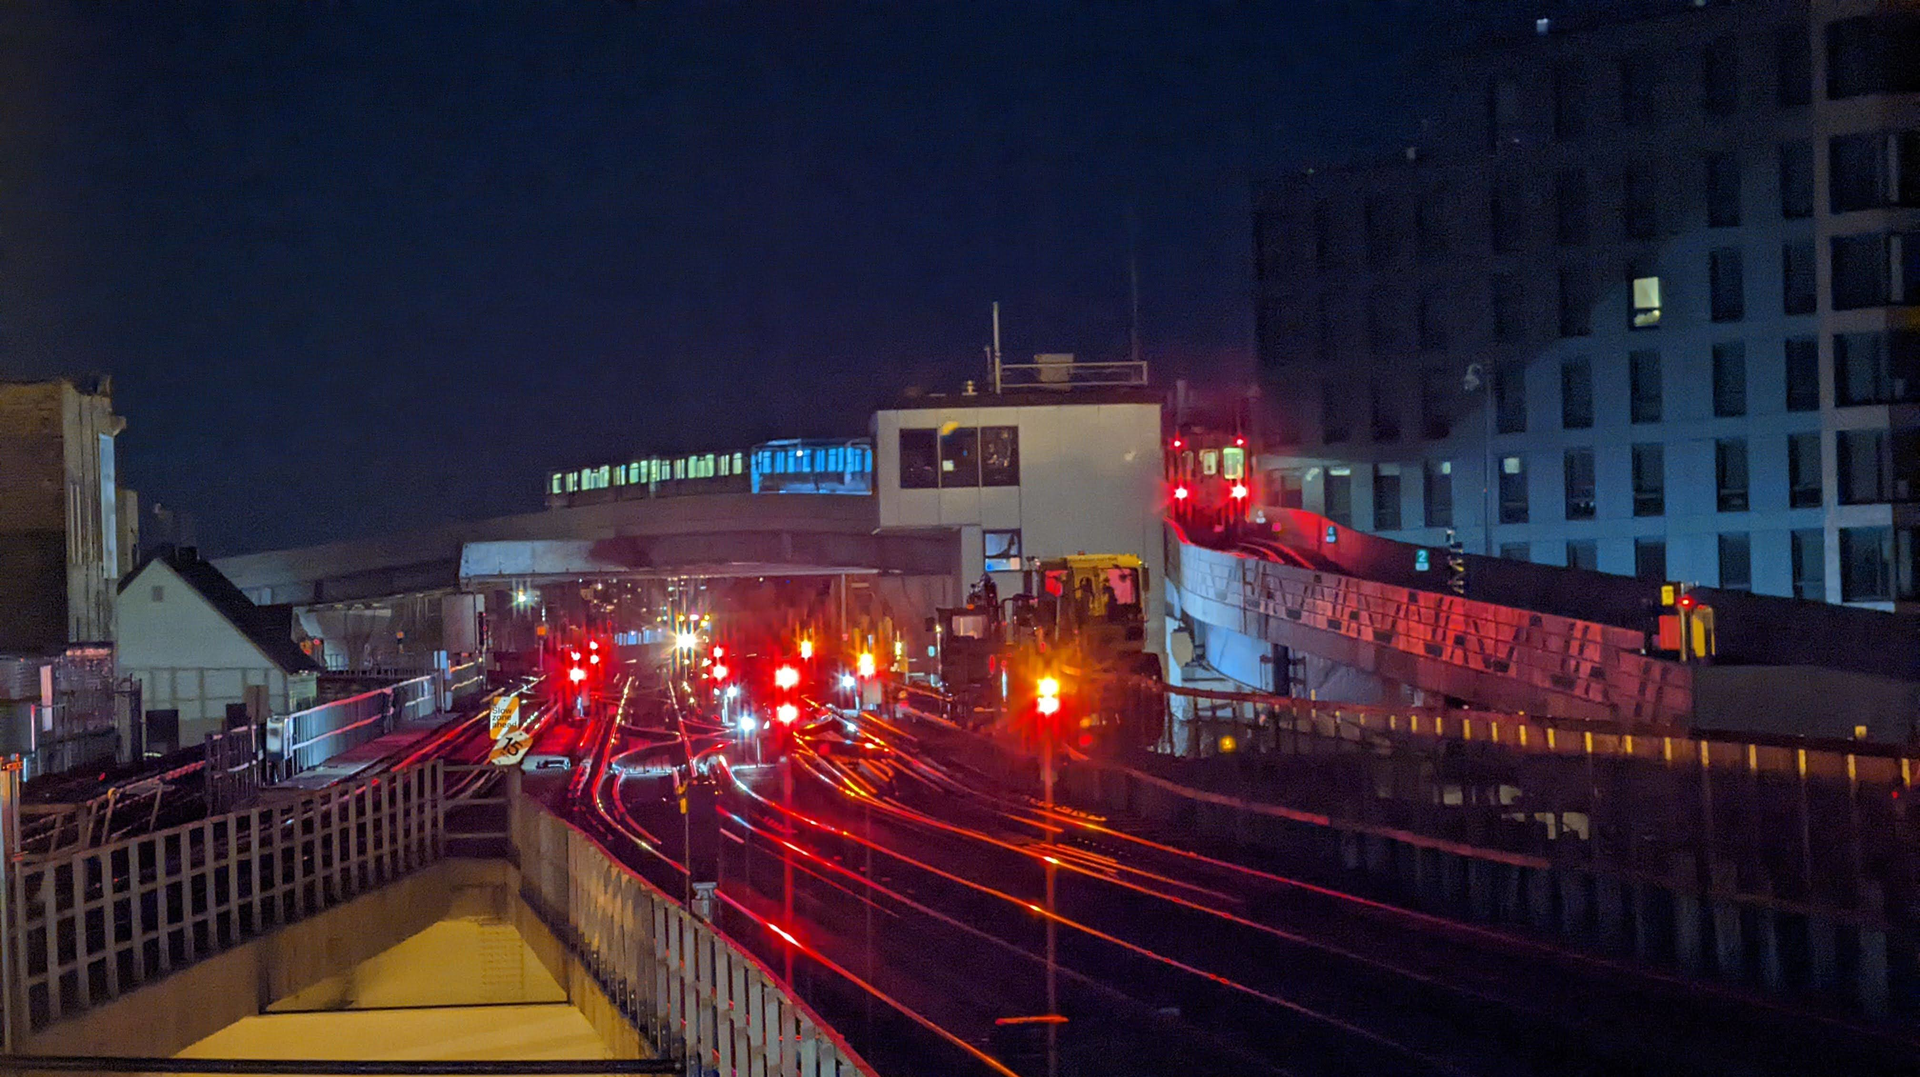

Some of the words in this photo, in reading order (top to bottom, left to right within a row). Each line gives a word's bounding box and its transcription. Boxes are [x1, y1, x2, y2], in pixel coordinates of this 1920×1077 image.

[1418, 550, 1426, 561] 2
[492, 706, 512, 714] Slow
[502, 737, 523, 756] 15
